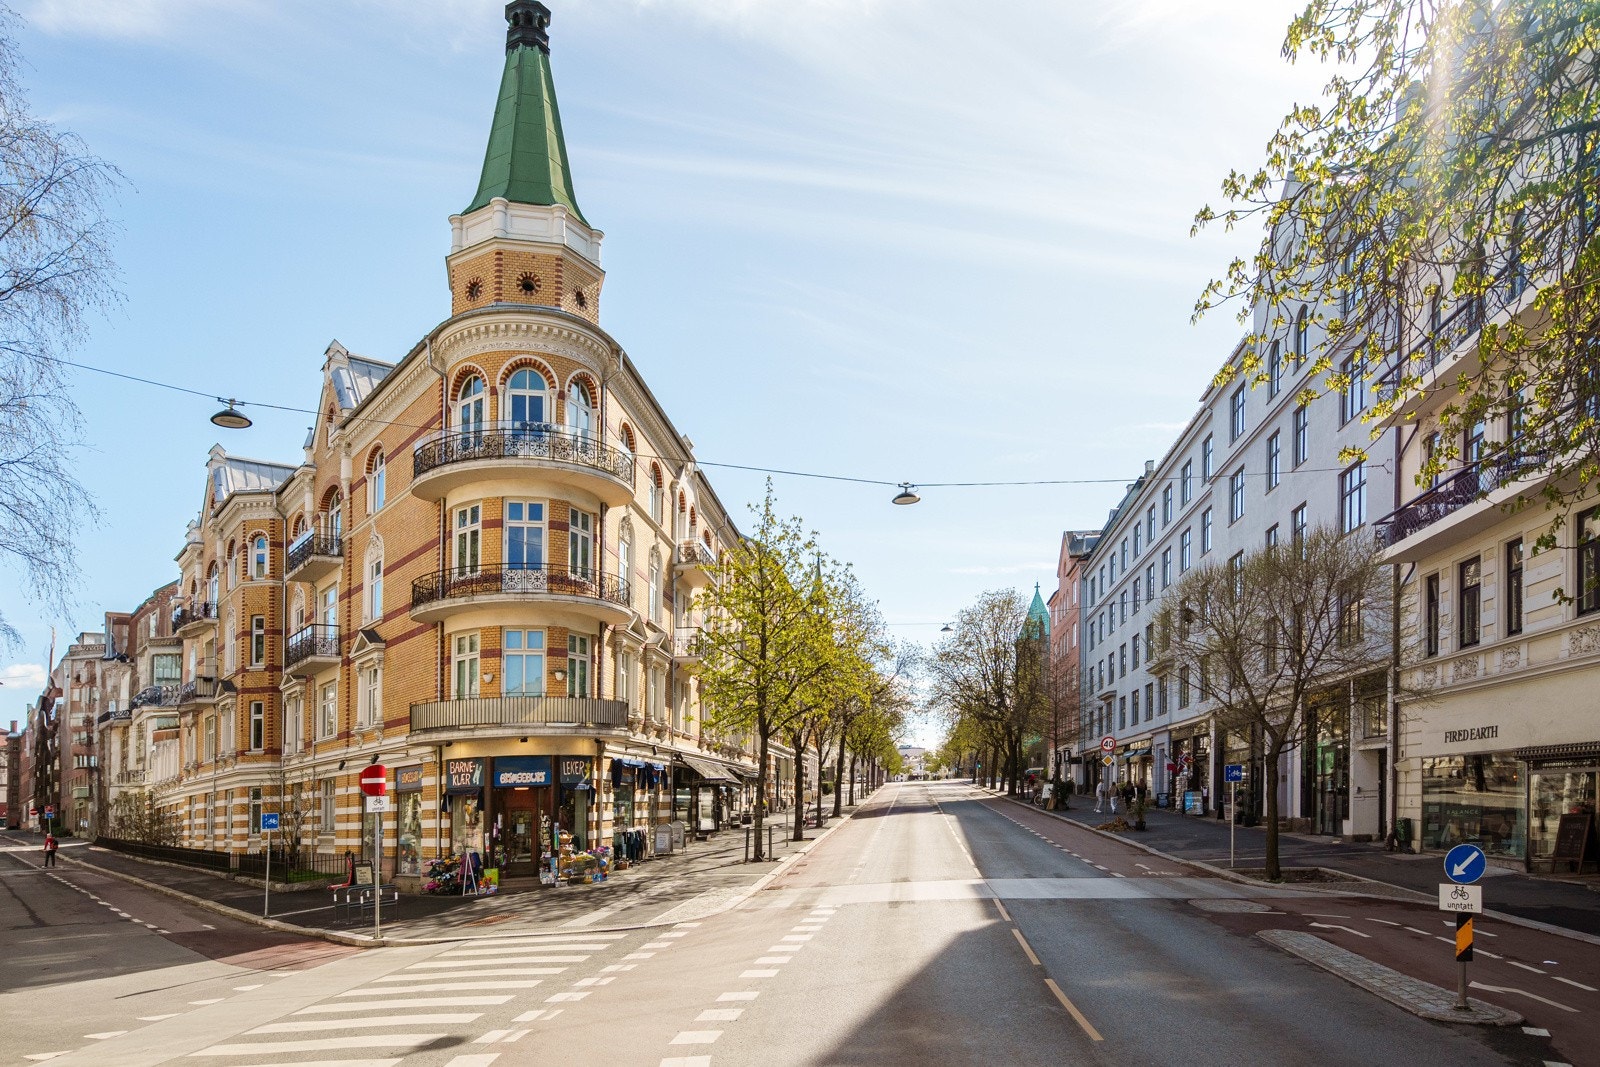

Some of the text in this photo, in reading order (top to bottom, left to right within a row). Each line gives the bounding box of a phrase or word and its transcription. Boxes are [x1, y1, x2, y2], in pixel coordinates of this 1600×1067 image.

[1444, 725, 1498, 743] FIRED EARTH
[1103, 740, 1114, 748] 40
[449, 761, 476, 775] BARNE-
[562, 760, 585, 777] LEKER
[452, 773, 471, 786] KLÆR
[1447, 902, 1474, 910] unntatt
